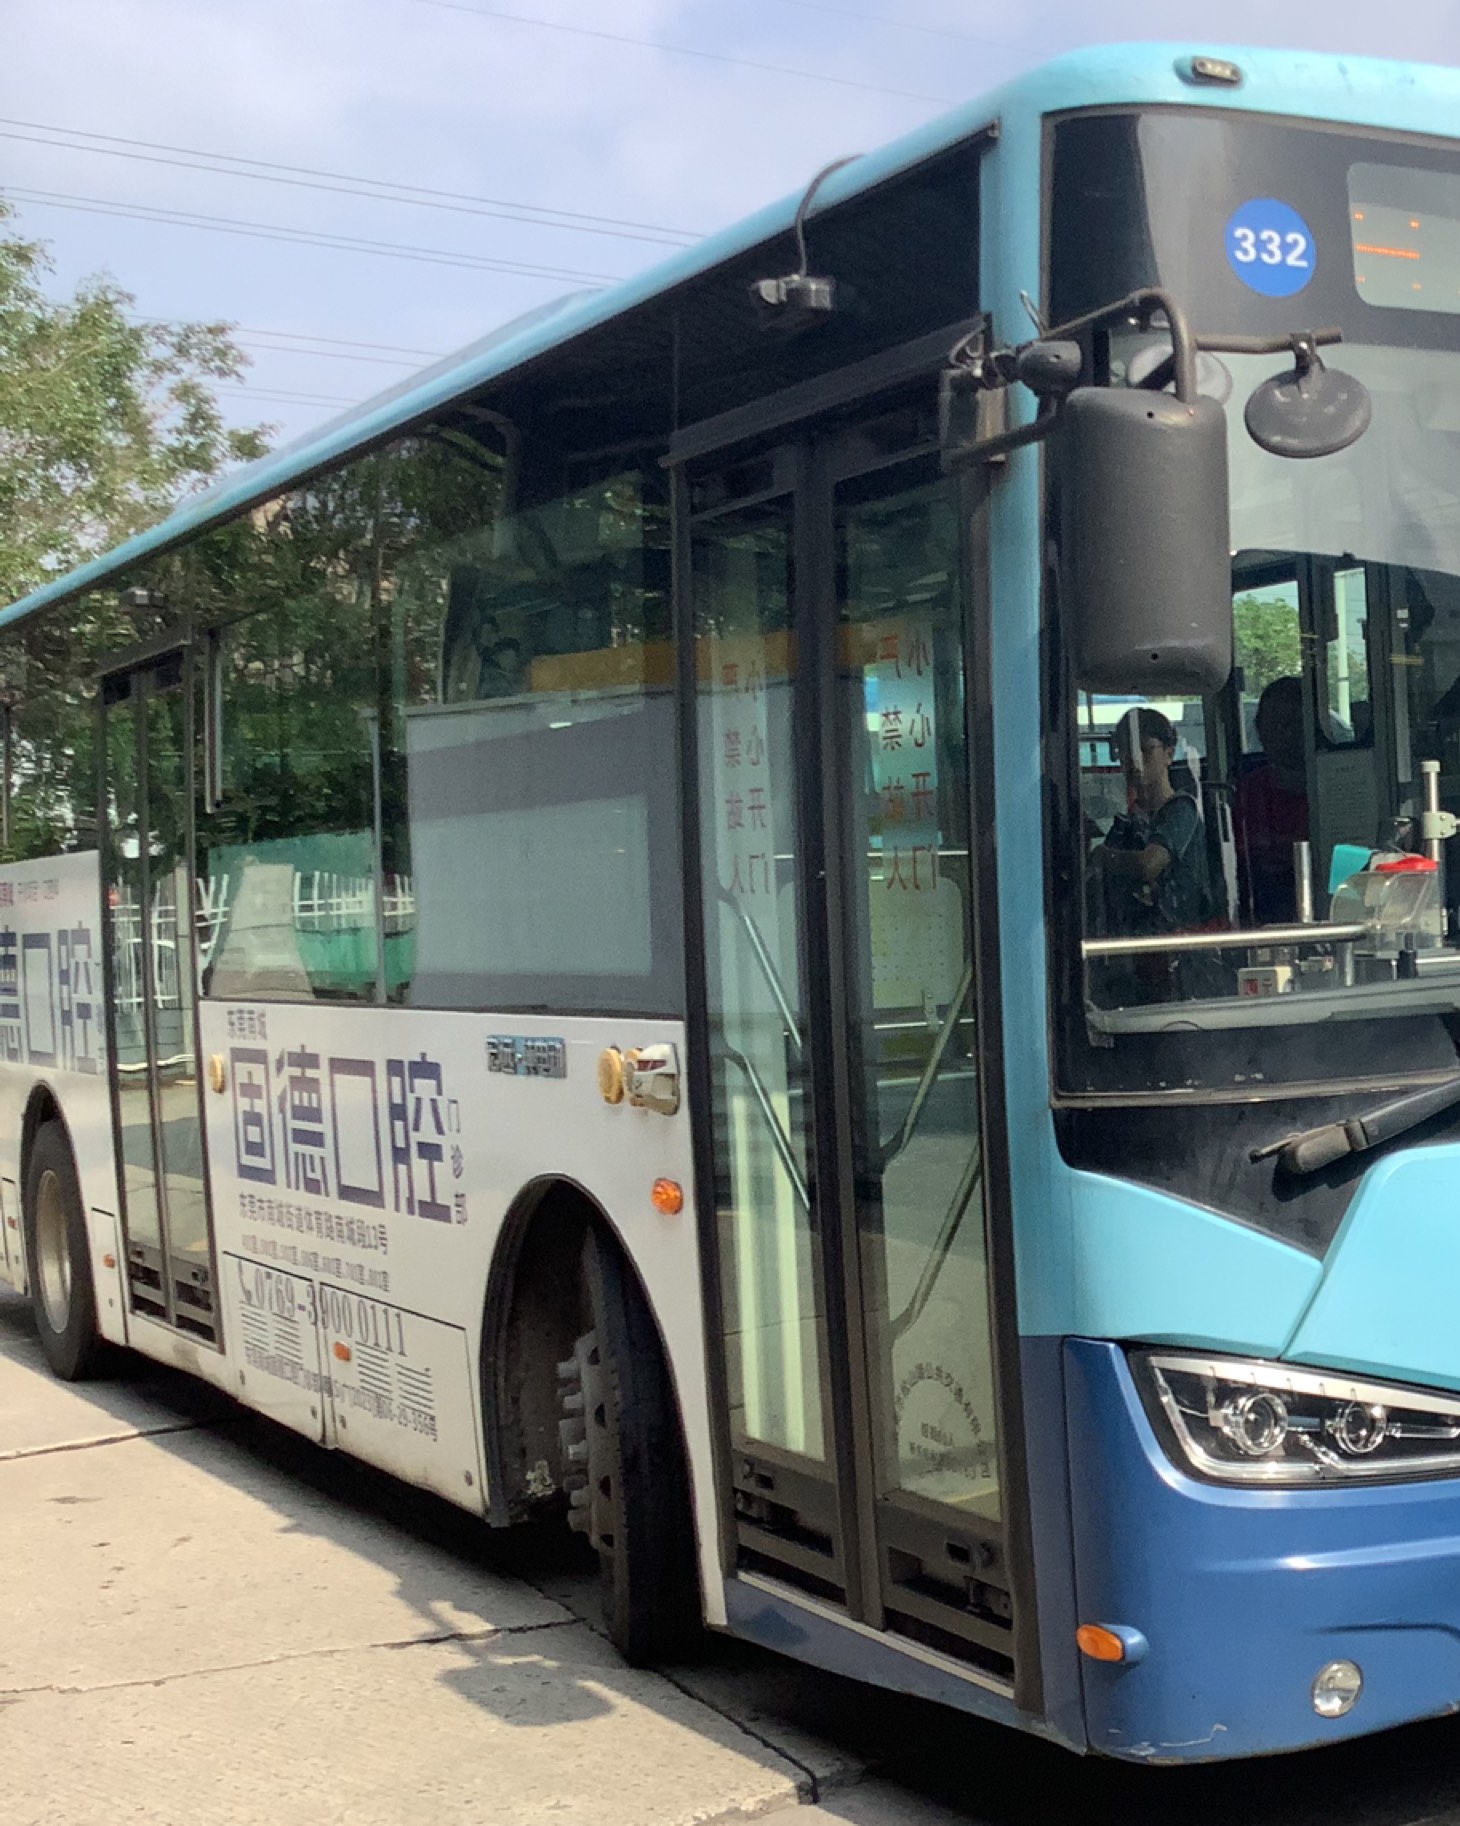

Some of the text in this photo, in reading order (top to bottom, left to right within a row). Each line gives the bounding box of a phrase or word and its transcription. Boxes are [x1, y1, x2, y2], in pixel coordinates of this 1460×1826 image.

[1234, 226, 1309, 268] 332
[230, 1044, 452, 1224] 固德口腔
